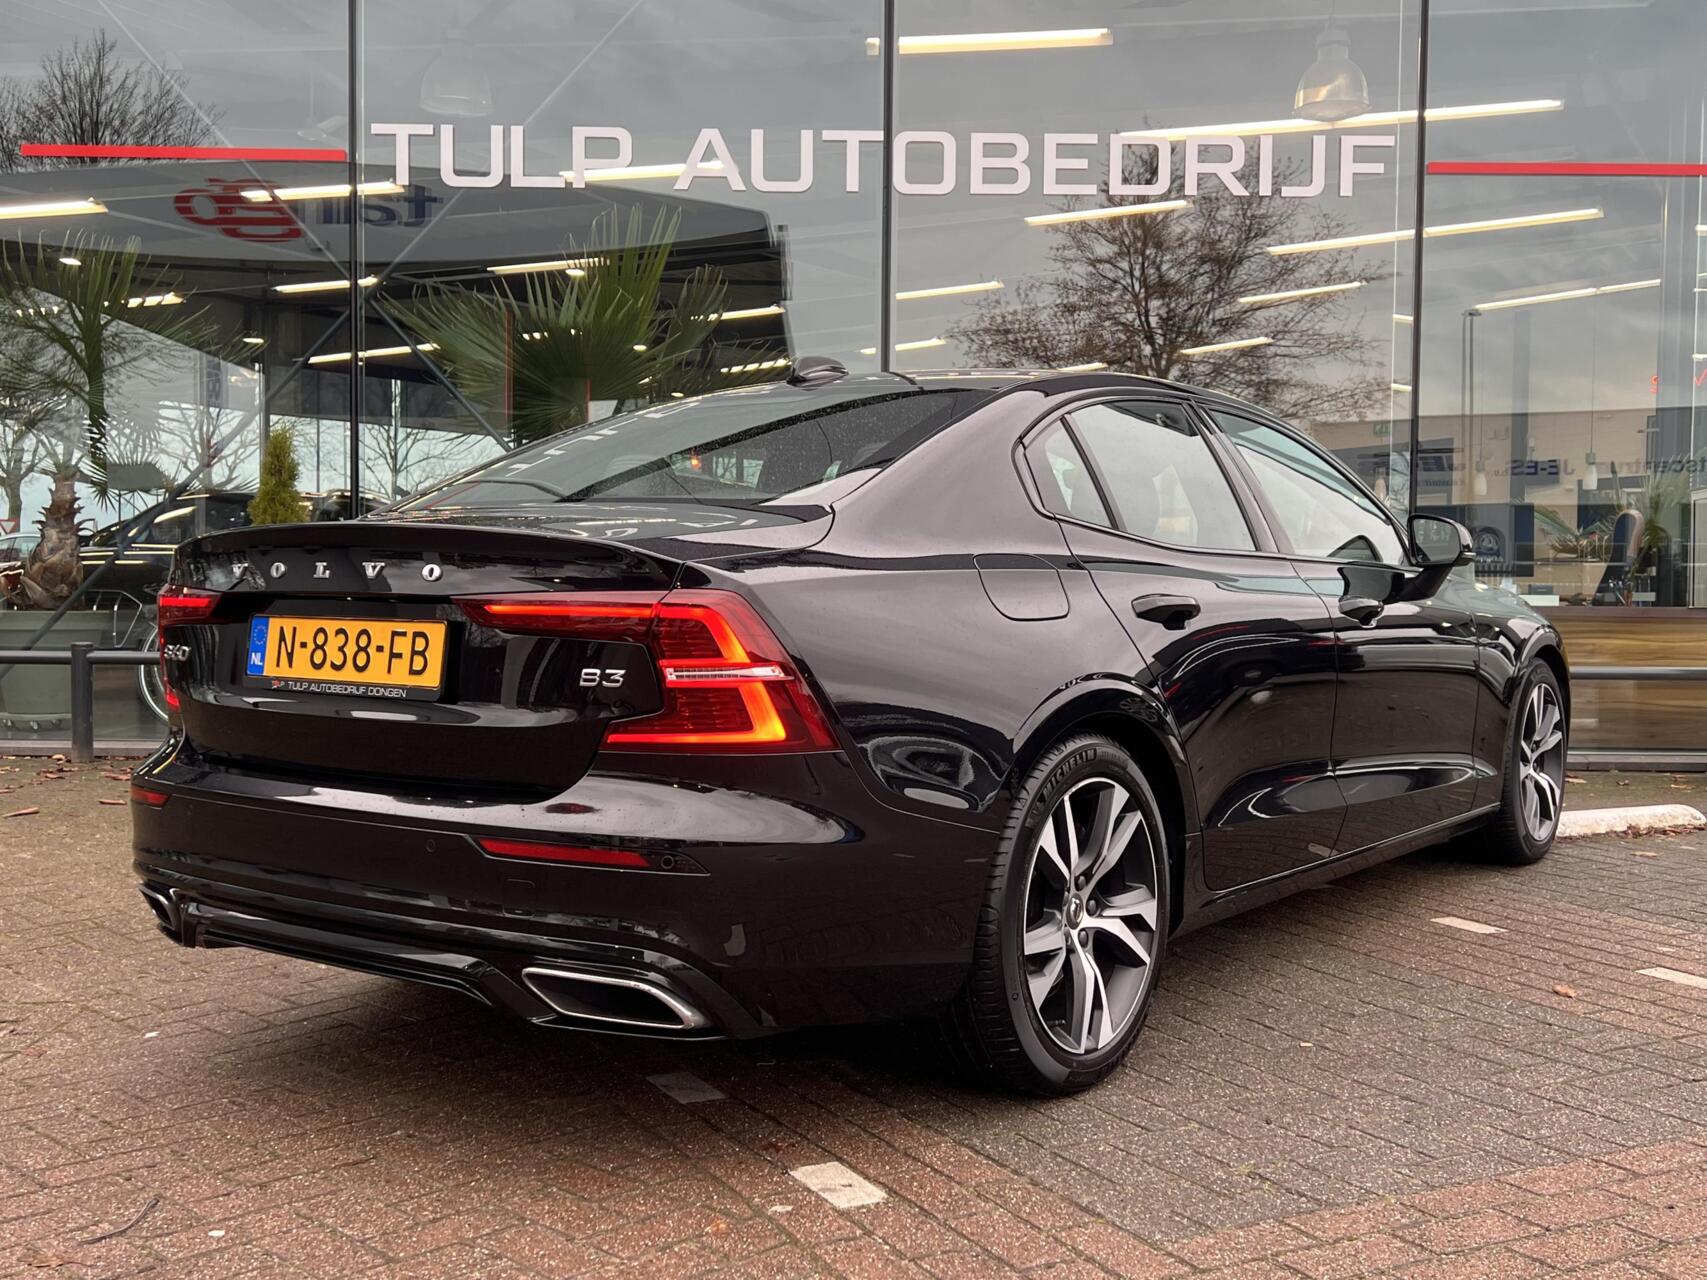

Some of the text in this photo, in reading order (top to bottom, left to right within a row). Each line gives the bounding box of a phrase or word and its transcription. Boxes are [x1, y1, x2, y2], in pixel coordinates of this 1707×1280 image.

[370, 122, 1396, 198] TULP AUTOBEDRIJF
[232, 562, 442, 581] VOLVO
[250, 652, 263, 666] NL
[276, 625, 430, 676] N-838-FB
[579, 668, 627, 688] B3
[287, 681, 309, 692] TULP
[309, 682, 367, 696] AUTOBEDRIJF
[368, 686, 407, 698] DONGEN
[1042, 748, 1095, 801] MICHELIN
